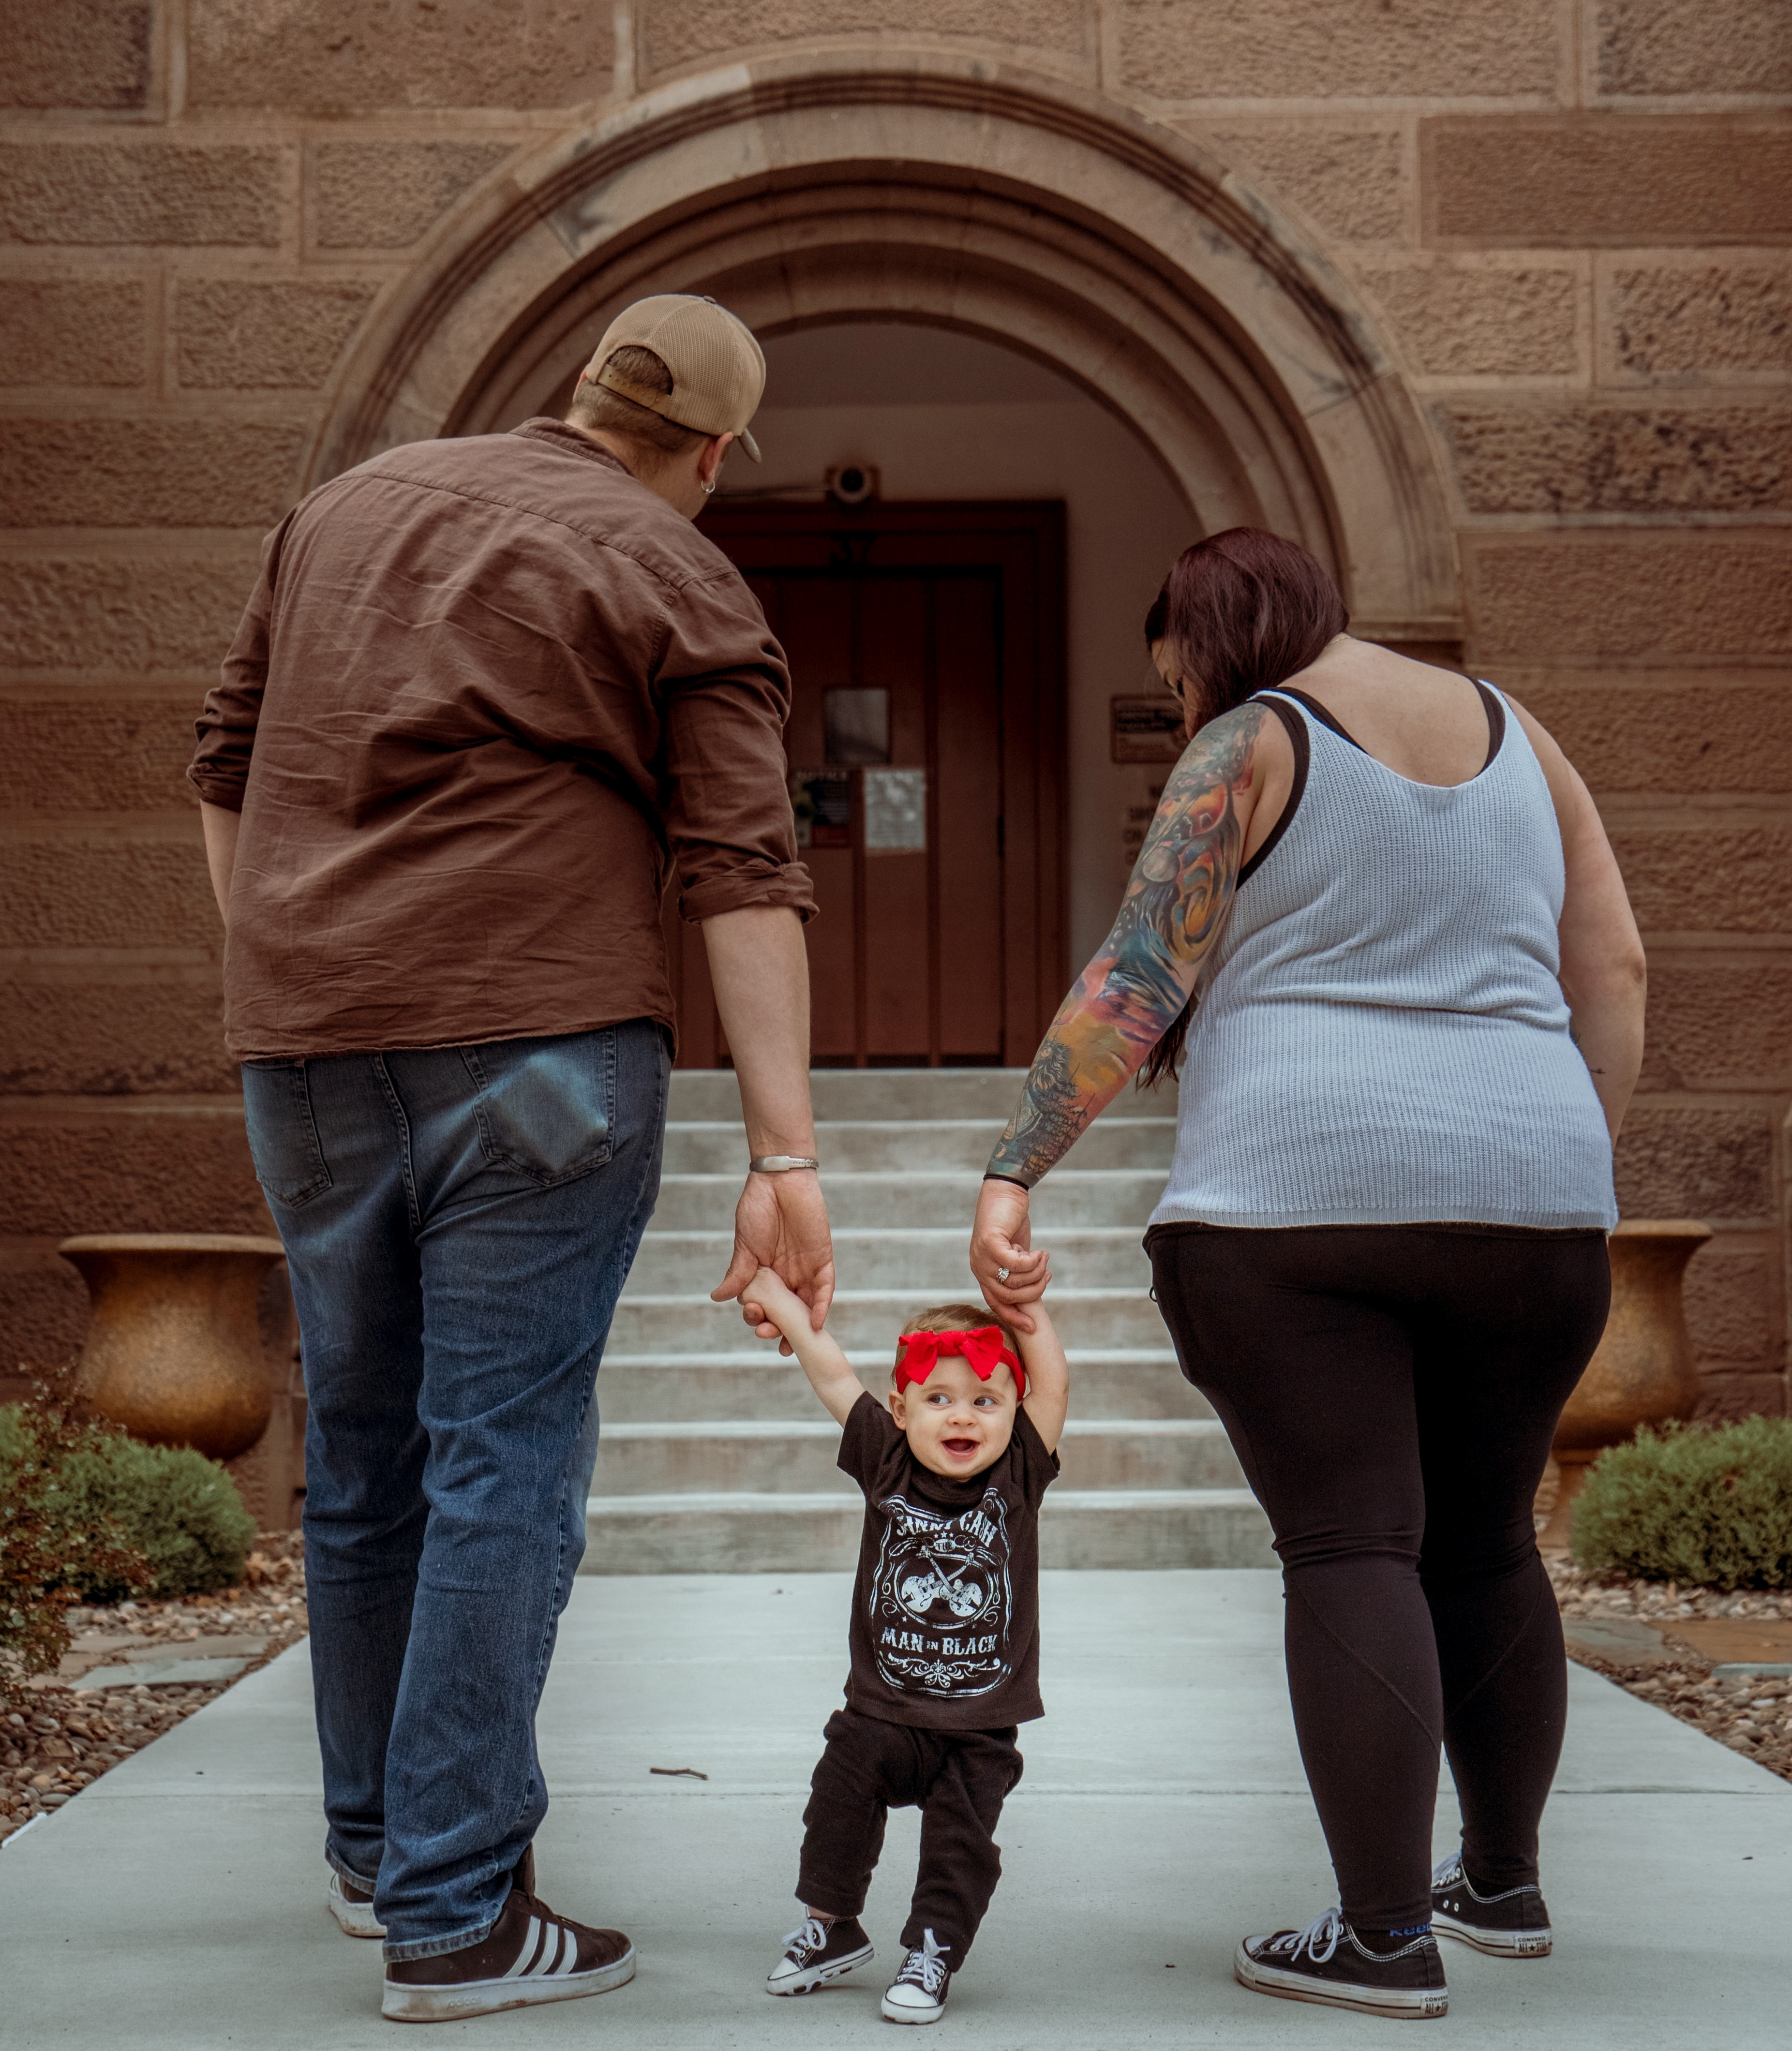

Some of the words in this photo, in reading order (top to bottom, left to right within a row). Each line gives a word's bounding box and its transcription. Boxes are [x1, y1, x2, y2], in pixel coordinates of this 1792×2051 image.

[958, 1510, 999, 1547] CASH
[880, 1626, 925, 1653] MAN
[926, 1641, 939, 1650] IN
[942, 1634, 998, 1655] BLACK
[1519, 1943, 1528, 1953] ALL
[1425, 2003, 1434, 2015] ALL
